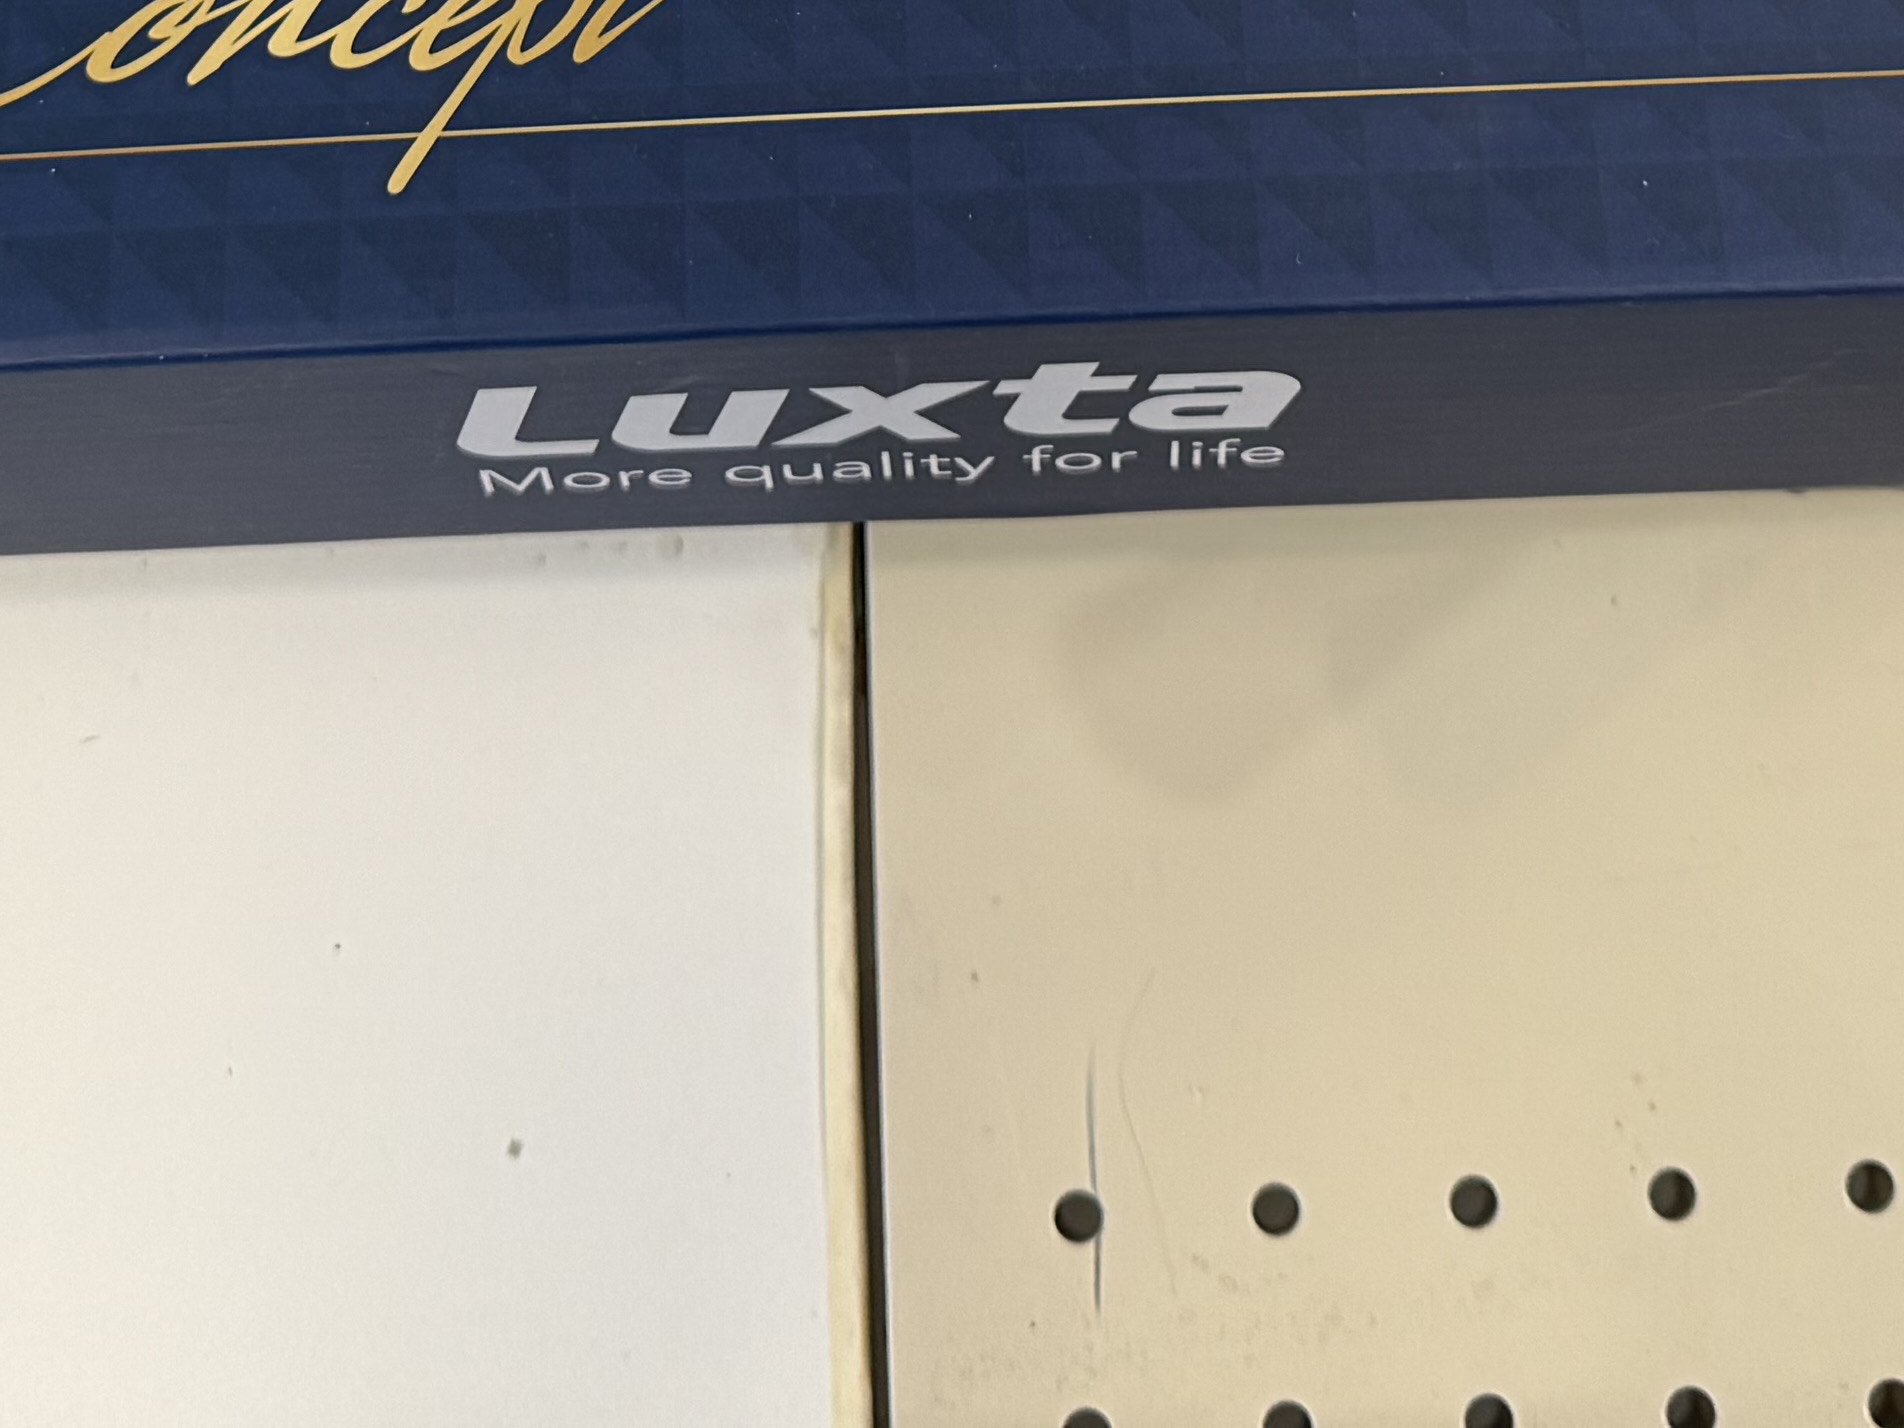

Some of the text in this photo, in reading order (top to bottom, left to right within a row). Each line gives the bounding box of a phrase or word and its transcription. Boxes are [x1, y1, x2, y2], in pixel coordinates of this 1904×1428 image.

[456, 360, 1302, 458] Luxta
[477, 436, 1288, 498] More quality for life
